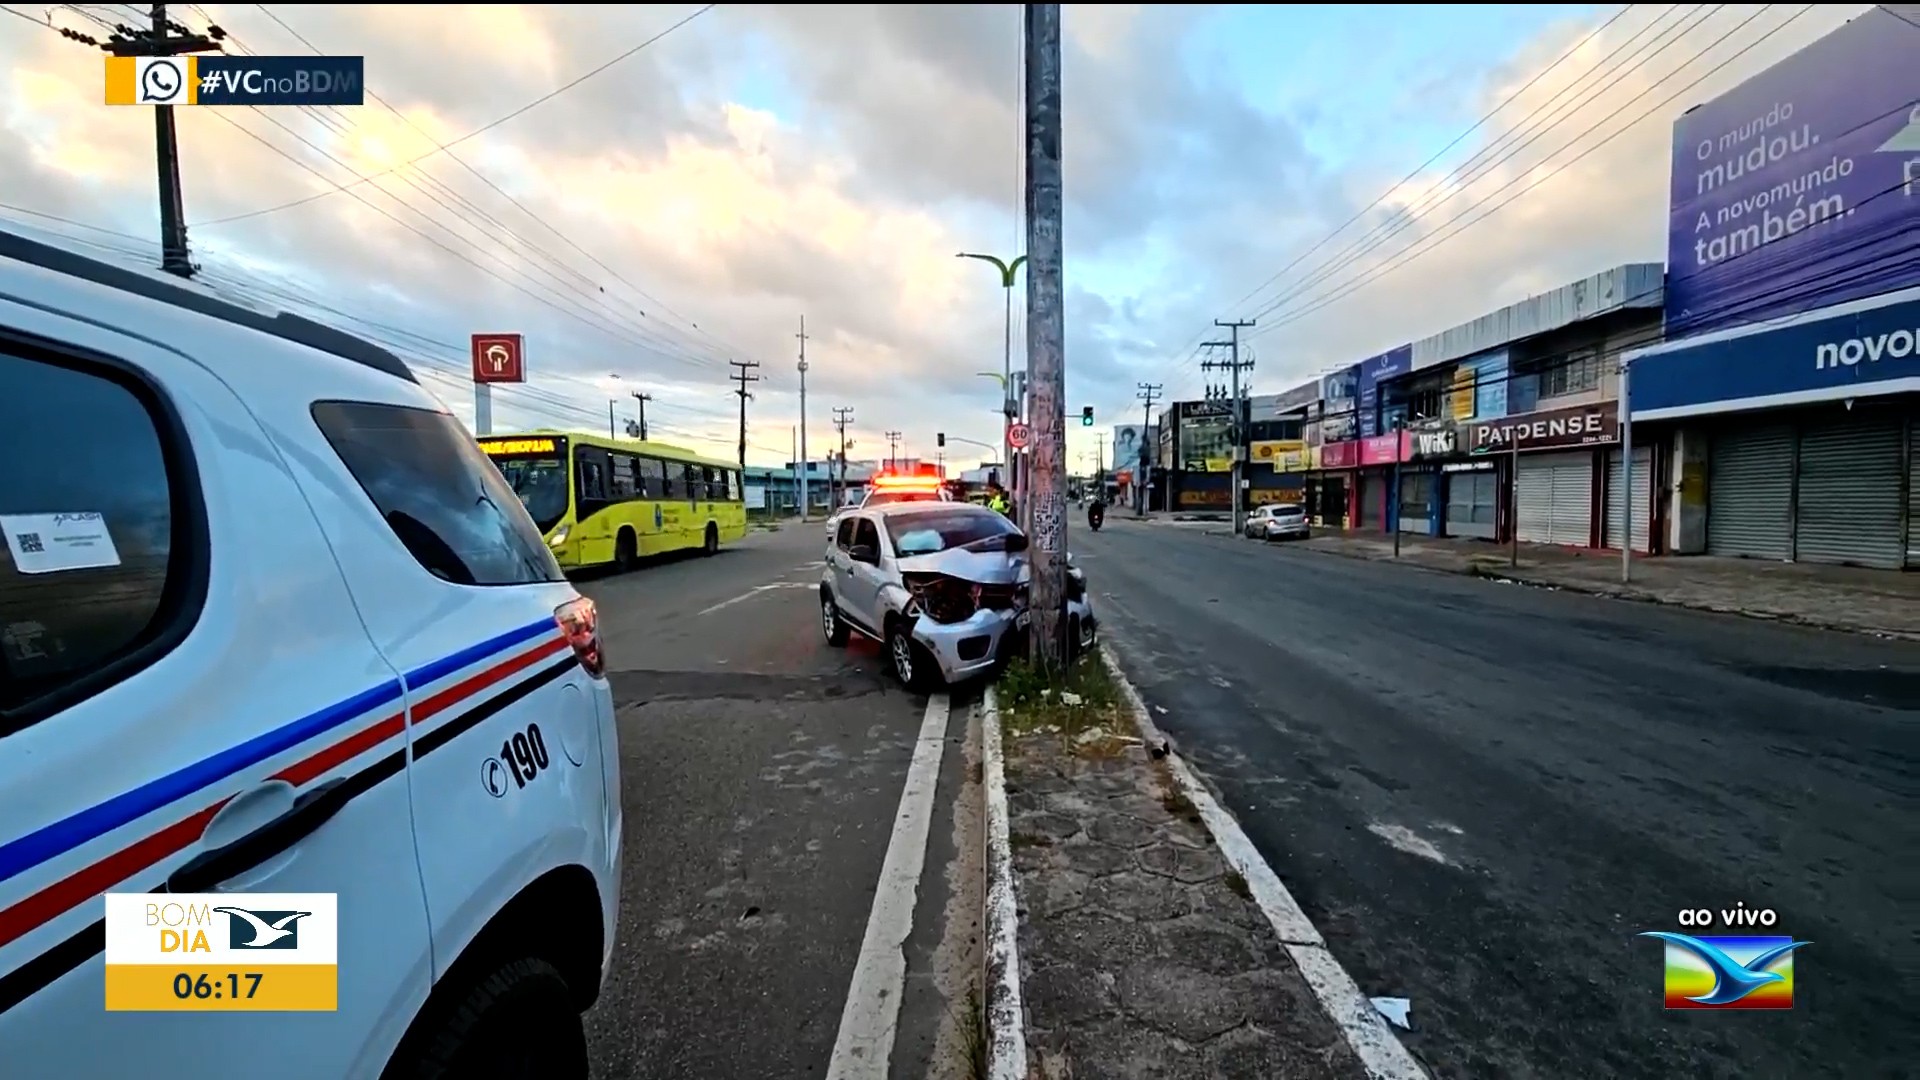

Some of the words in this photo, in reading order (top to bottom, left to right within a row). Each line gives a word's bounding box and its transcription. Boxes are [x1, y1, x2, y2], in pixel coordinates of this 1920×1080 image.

[1697, 140, 1712, 160] O
[1719, 103, 1793, 152] mundo
[1697, 124, 1819, 194] mudou.
[1695, 211, 1711, 233] A
[1717, 156, 1853, 224] novomundo
[1694, 193, 1855, 265] também.
[1012, 429, 1027, 440] 60
[1477, 413, 1602, 444] PATOENSE
[500, 722, 549, 790] 190
